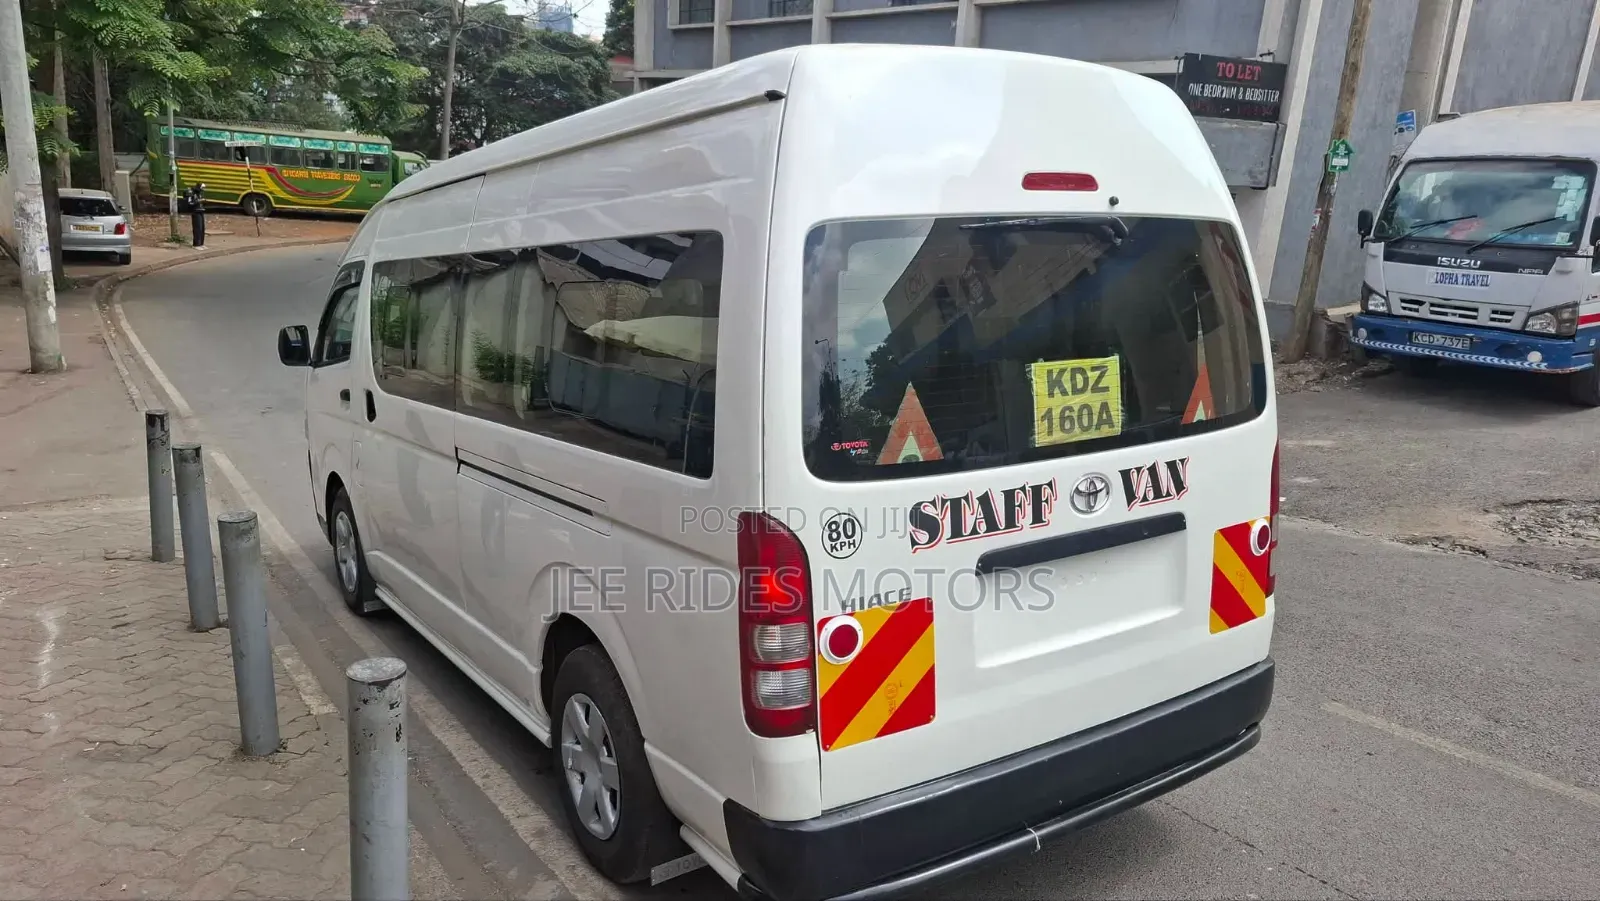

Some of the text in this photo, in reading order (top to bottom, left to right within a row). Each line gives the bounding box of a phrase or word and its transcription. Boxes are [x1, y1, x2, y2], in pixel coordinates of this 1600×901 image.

[1217, 62, 1262, 81] TO LET
[1188, 83, 1202, 97] ONE
[1238, 87, 1244, 100] &
[1245, 87, 1280, 102] BEDSITTER
[1437, 256, 1481, 268] ISUZU
[1434, 272, 1490, 287] LOPHA TRAVEL
[1046, 365, 1110, 398] KDZ
[1041, 401, 1115, 436] 160A
[841, 440, 869, 449] TOYOTA
[909, 456, 1191, 553] STAFF VAN
[827, 518, 857, 541] 80
[829, 539, 857, 554] KPH
[841, 587, 912, 612] HIACE
